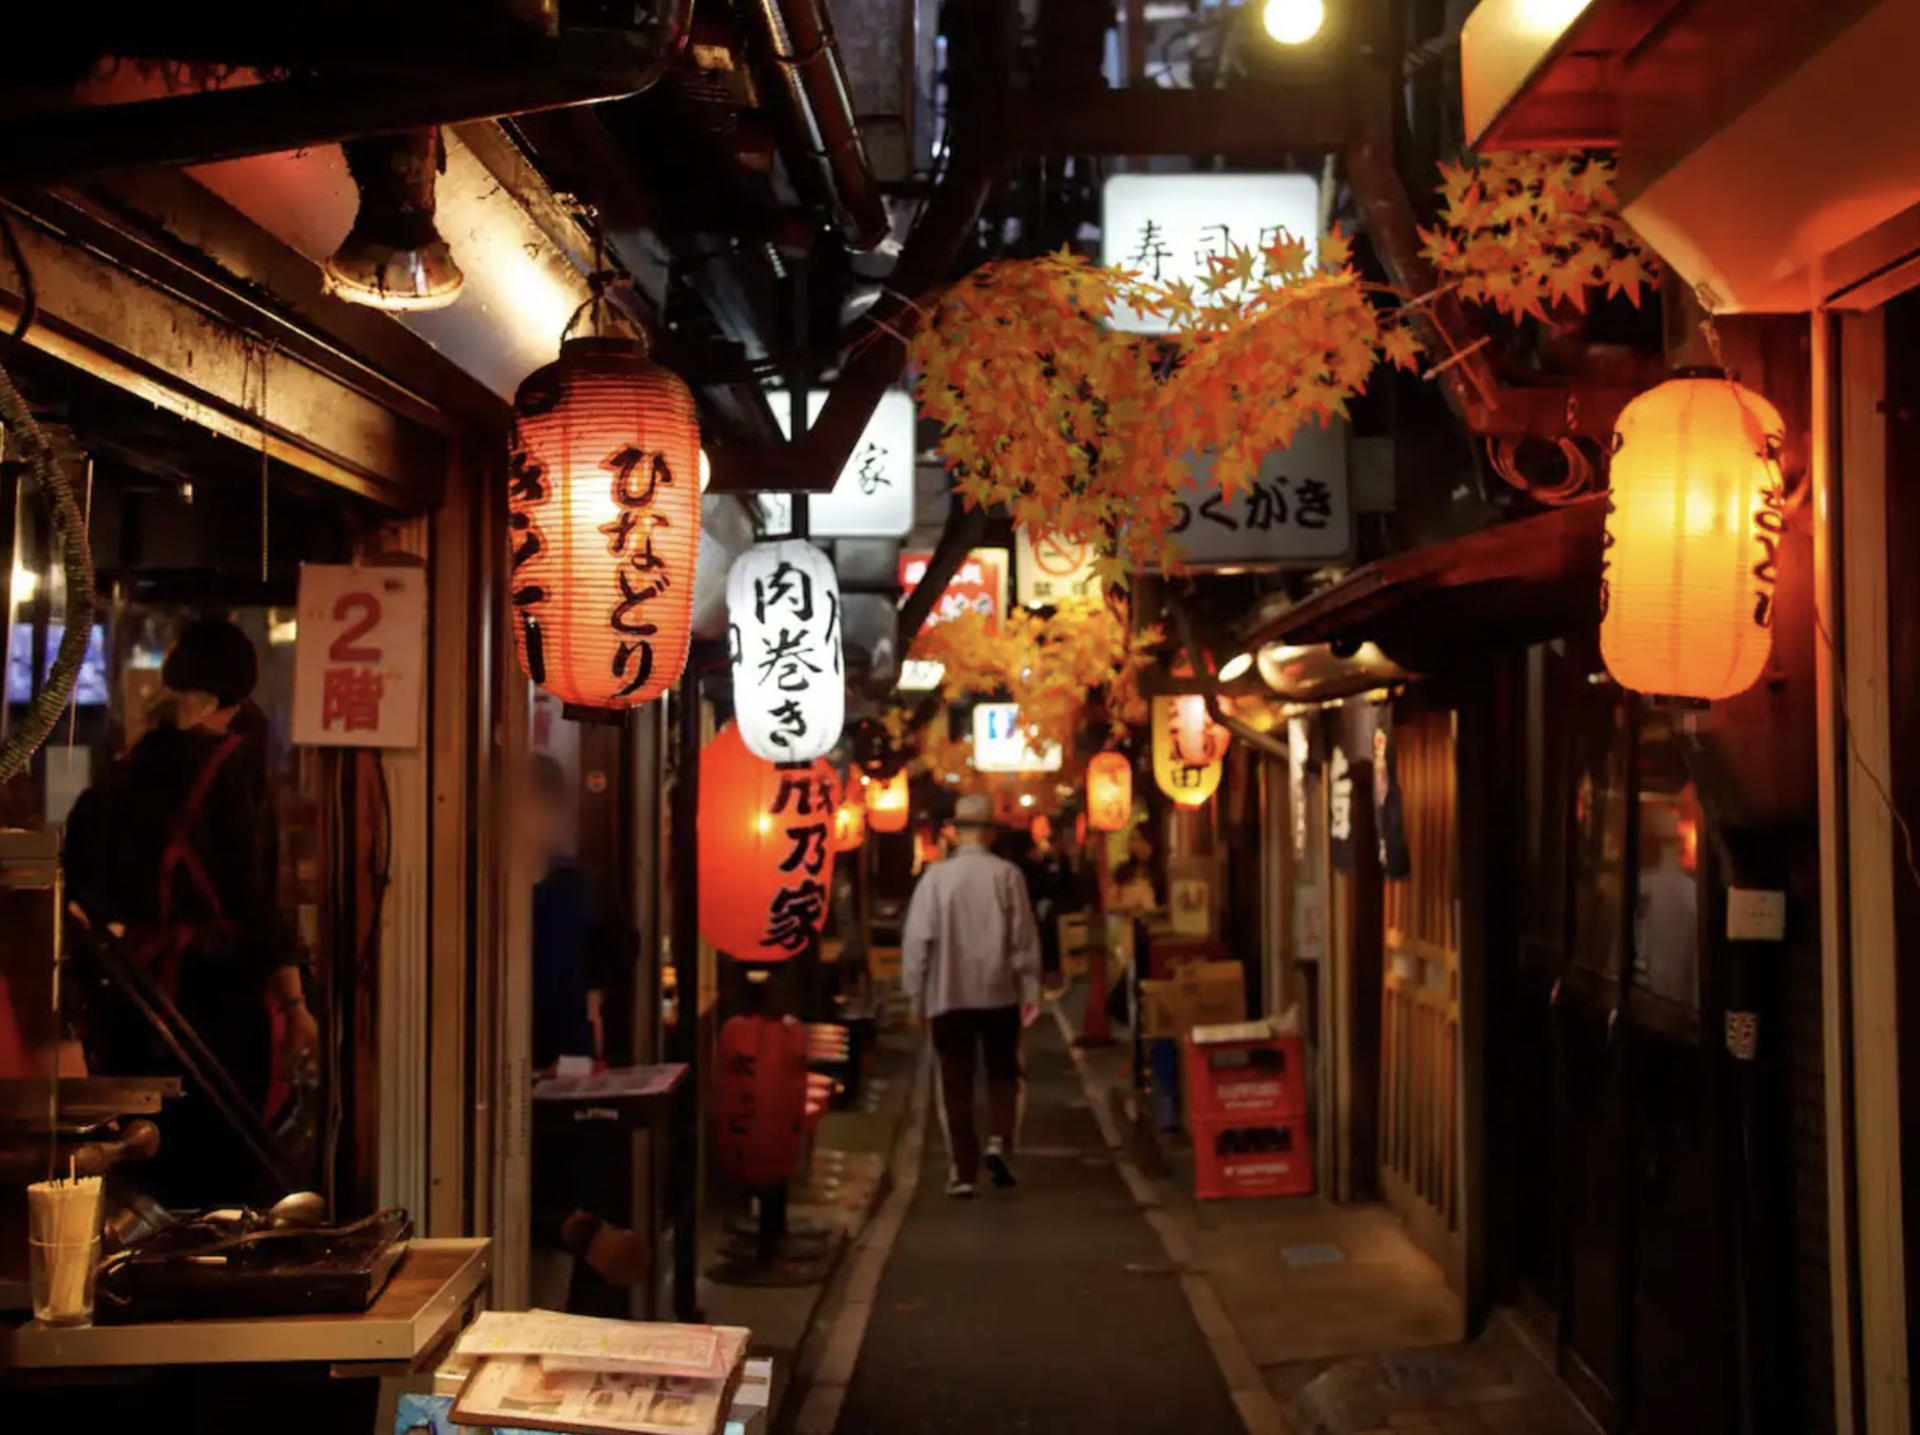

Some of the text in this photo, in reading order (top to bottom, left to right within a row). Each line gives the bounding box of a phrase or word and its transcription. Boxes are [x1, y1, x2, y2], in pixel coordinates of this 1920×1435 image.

[322, 591, 384, 732] 2階
[600, 445, 673, 698] ひなどり
[754, 561, 824, 749] 肉巻き
